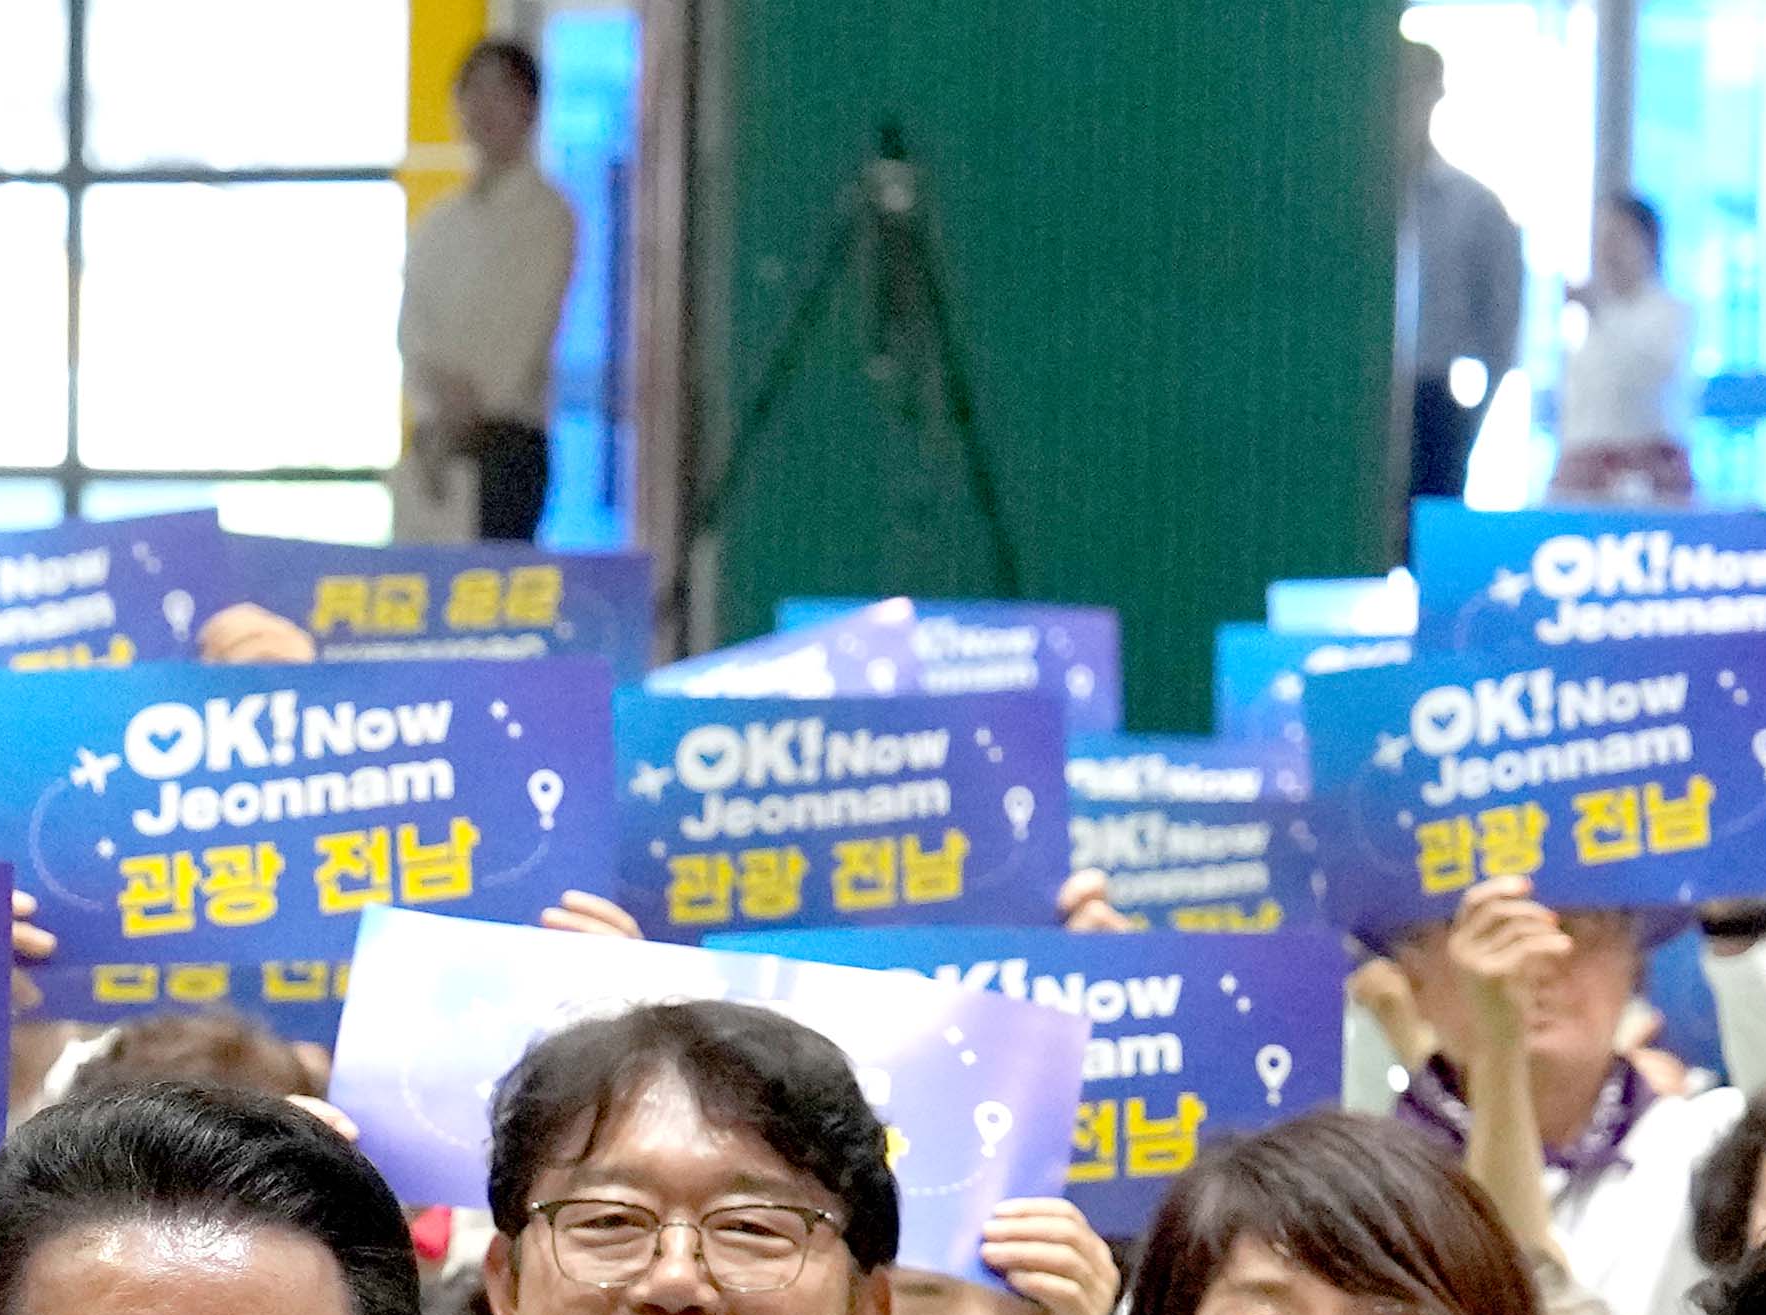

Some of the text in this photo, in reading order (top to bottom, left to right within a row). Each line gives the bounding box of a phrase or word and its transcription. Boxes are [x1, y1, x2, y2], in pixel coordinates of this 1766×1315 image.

[1534, 531, 1672, 598] OK!
[123, 689, 454, 781] OK! Now
[677, 718, 950, 792] OK! Now
[1411, 668, 1690, 758] OK! Now
[132, 757, 456, 838] Jeonnam
[1421, 724, 1693, 807] Jeonnam
[680, 778, 951, 842] Jeonnam
[1572, 774, 1716, 868] 전남
[116, 816, 482, 940] 관광 전남
[670, 825, 971, 926] 관광 전남
